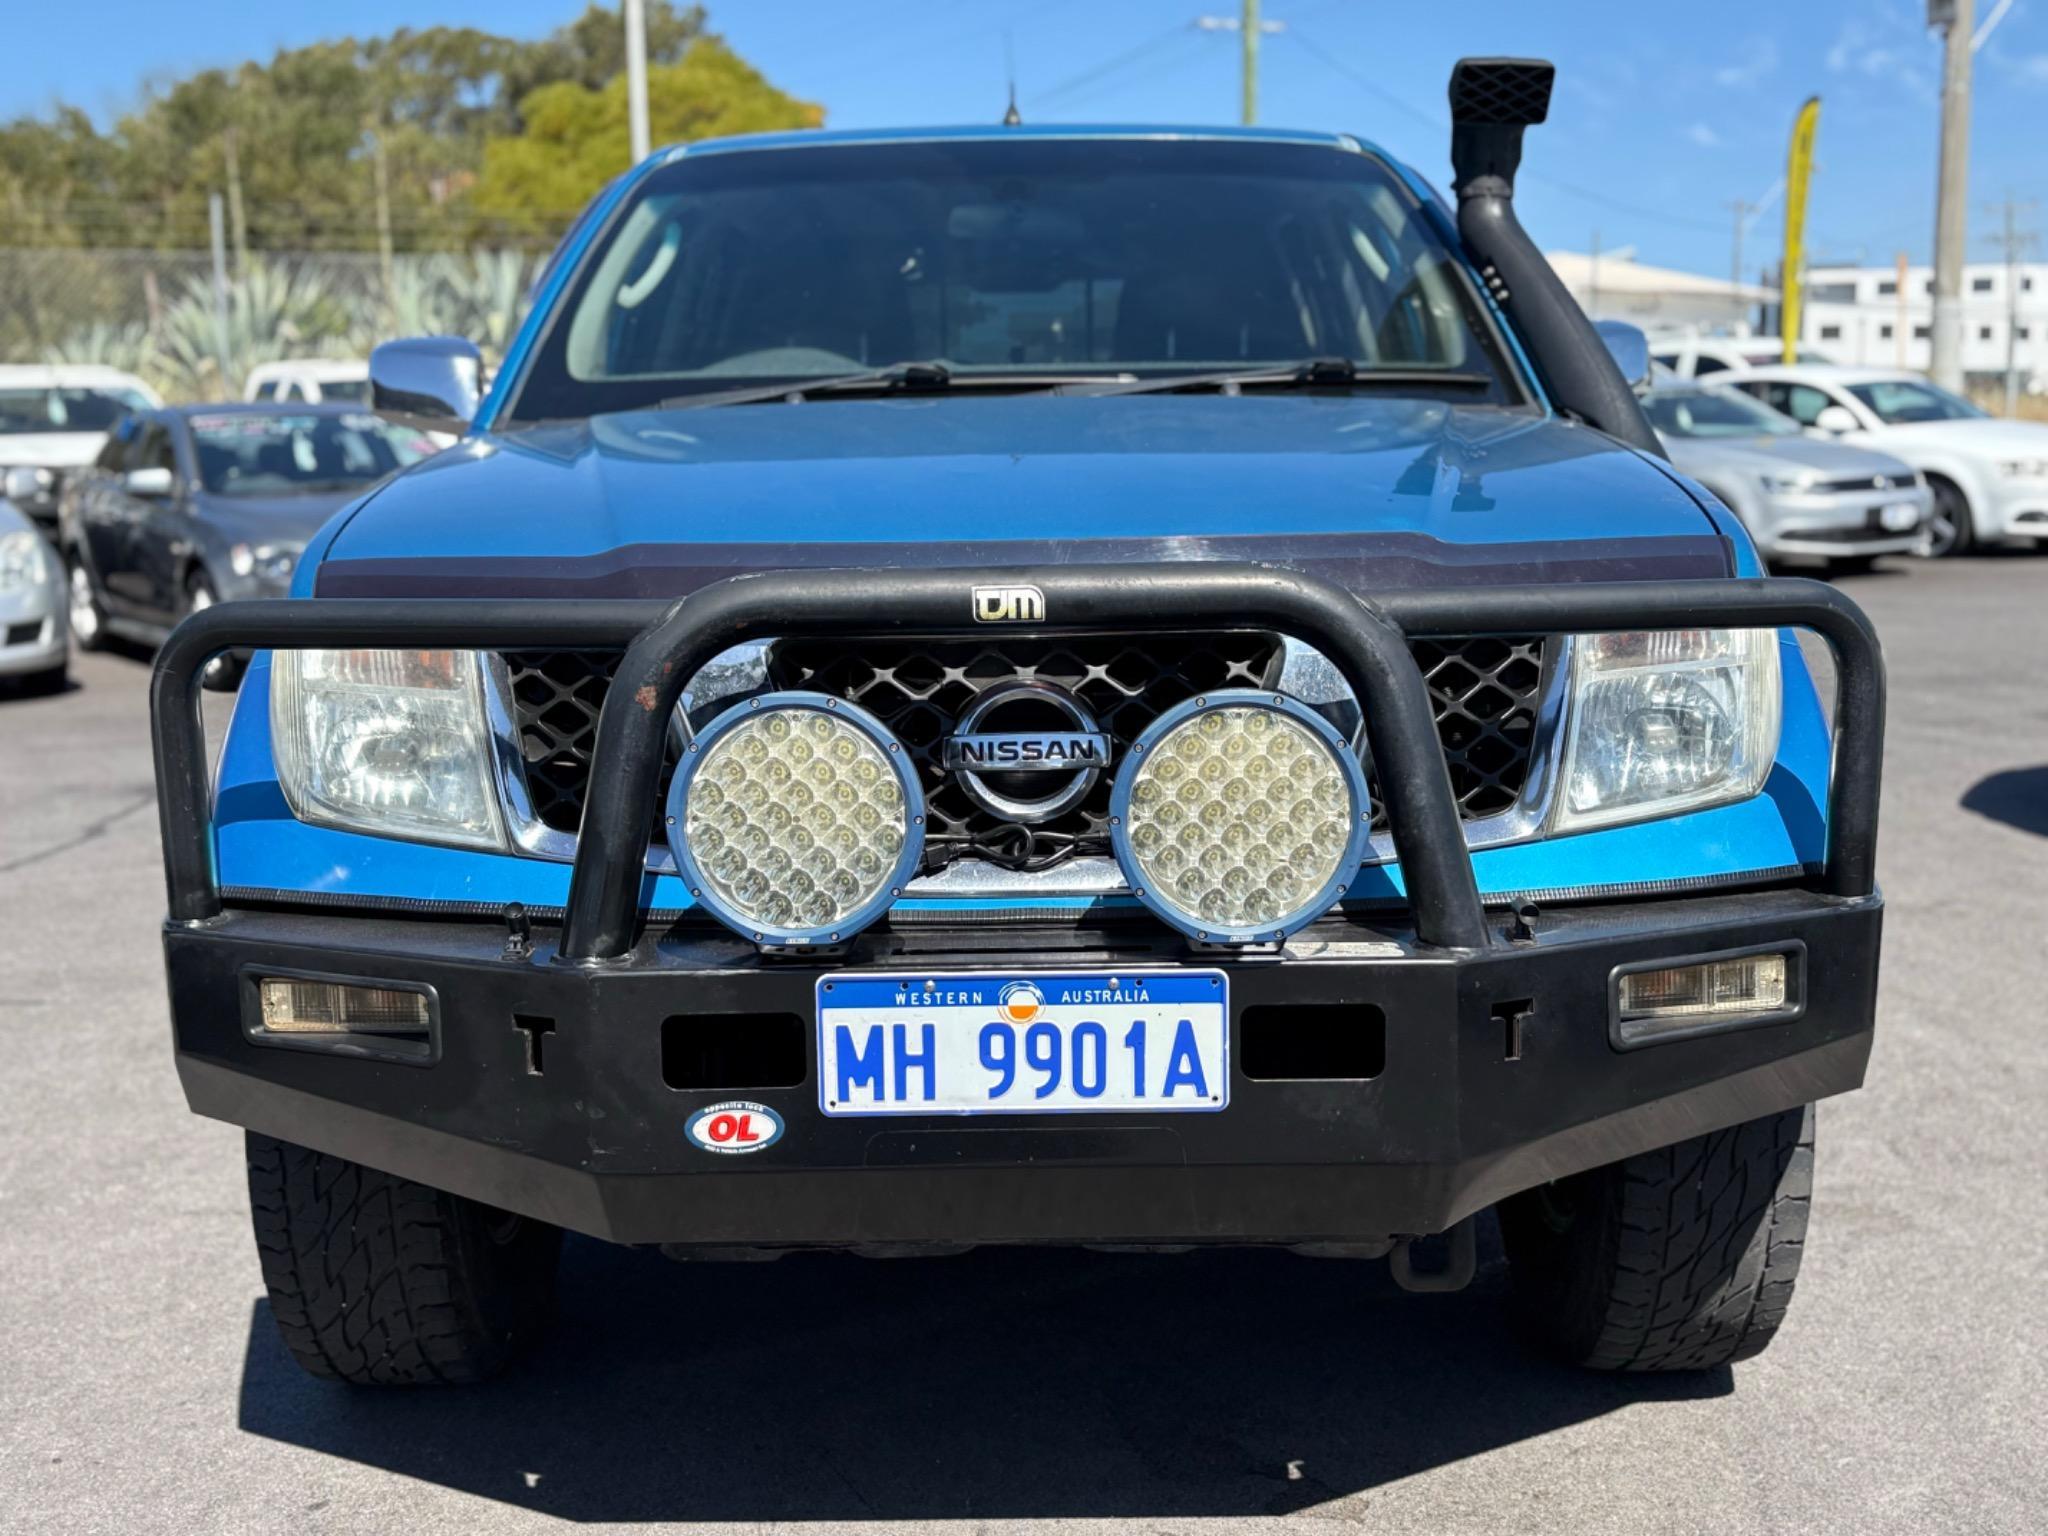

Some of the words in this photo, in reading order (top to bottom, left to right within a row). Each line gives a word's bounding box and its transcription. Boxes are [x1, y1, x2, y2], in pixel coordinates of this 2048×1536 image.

[960, 739, 1094, 762] NISSAN
[895, 991, 983, 1005] WESTERN
[1061, 989, 1150, 1003] AUSTRALIA
[835, 1023, 936, 1103] MH
[978, 1019, 1209, 1099] 9901A
[708, 1114, 760, 1142] OL
